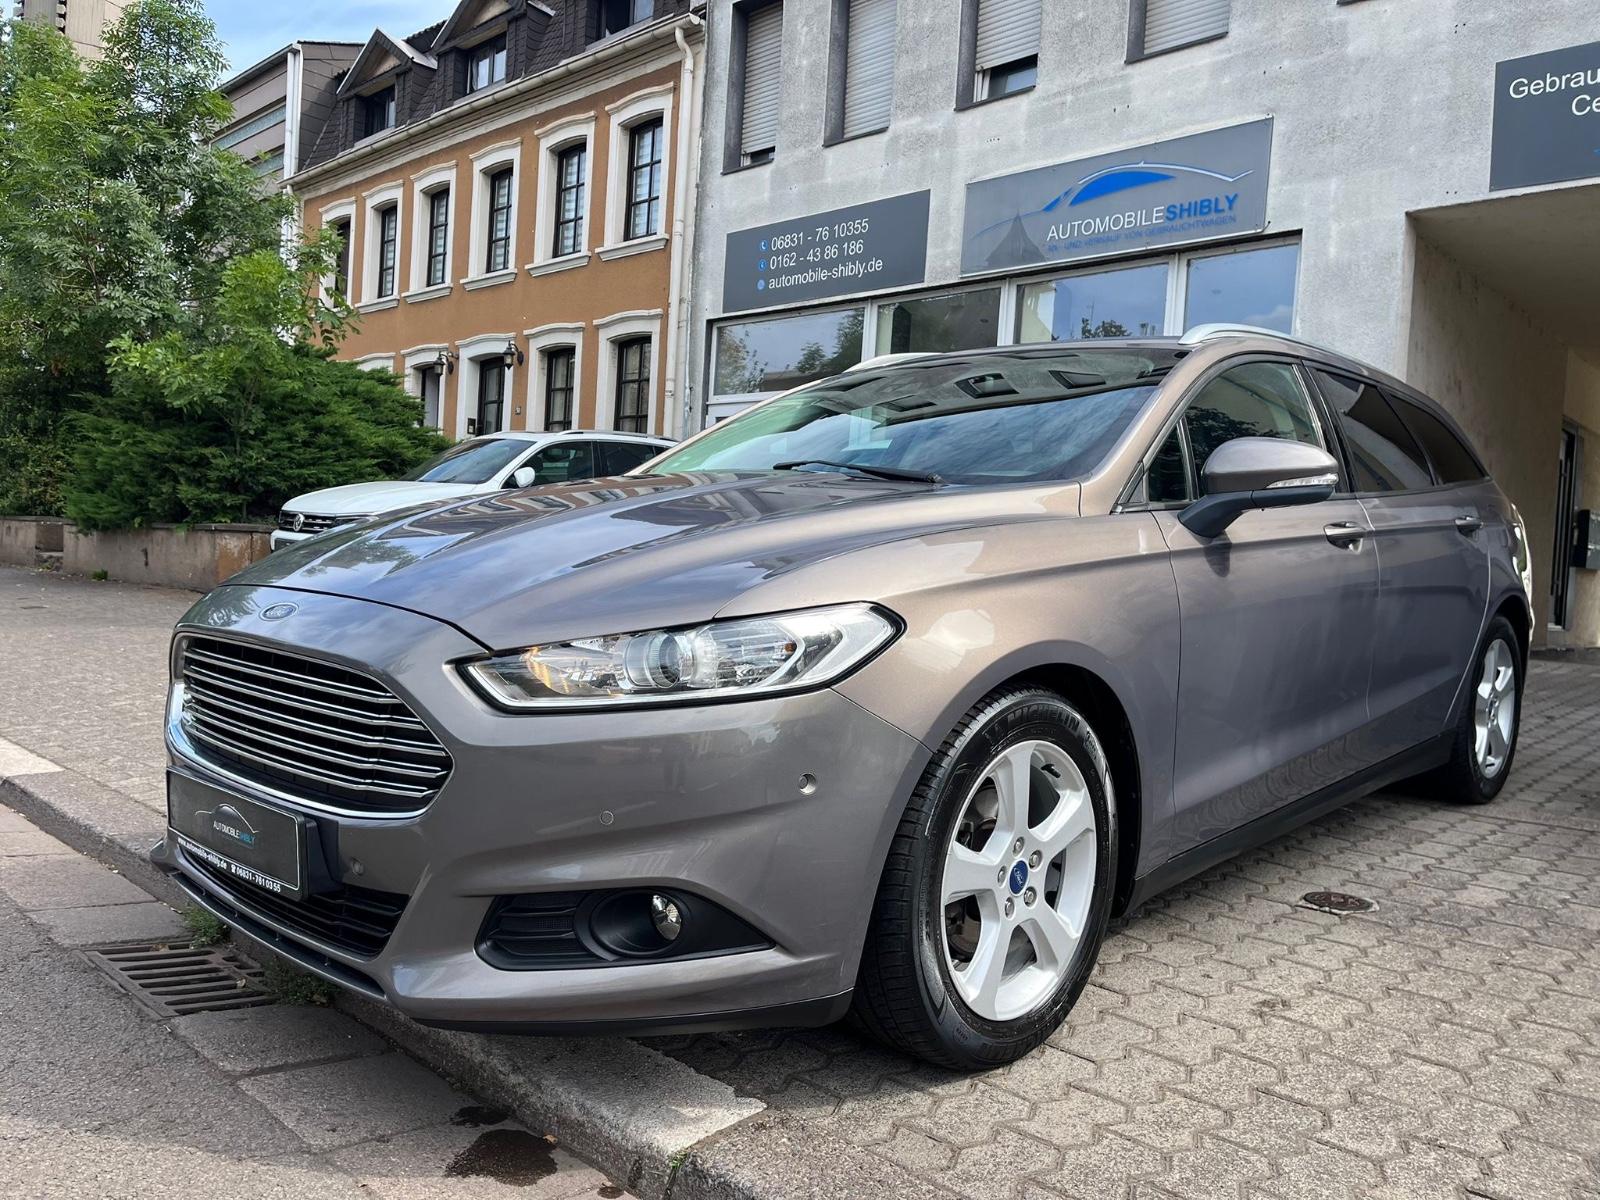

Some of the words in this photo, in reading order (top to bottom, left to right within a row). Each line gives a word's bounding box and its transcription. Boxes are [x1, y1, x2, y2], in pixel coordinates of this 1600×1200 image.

[1509, 68, 1600, 99] Gebrau
[771, 232, 803, 251] 06831
[815, 226, 829, 242] 76
[833, 218, 869, 238] 10355
[770, 252, 796, 270] 0162
[806, 248, 821, 263] 43
[824, 244, 838, 260] 86
[842, 239, 864, 256] 186
[768, 257, 883, 290] automobile-shibly.de
